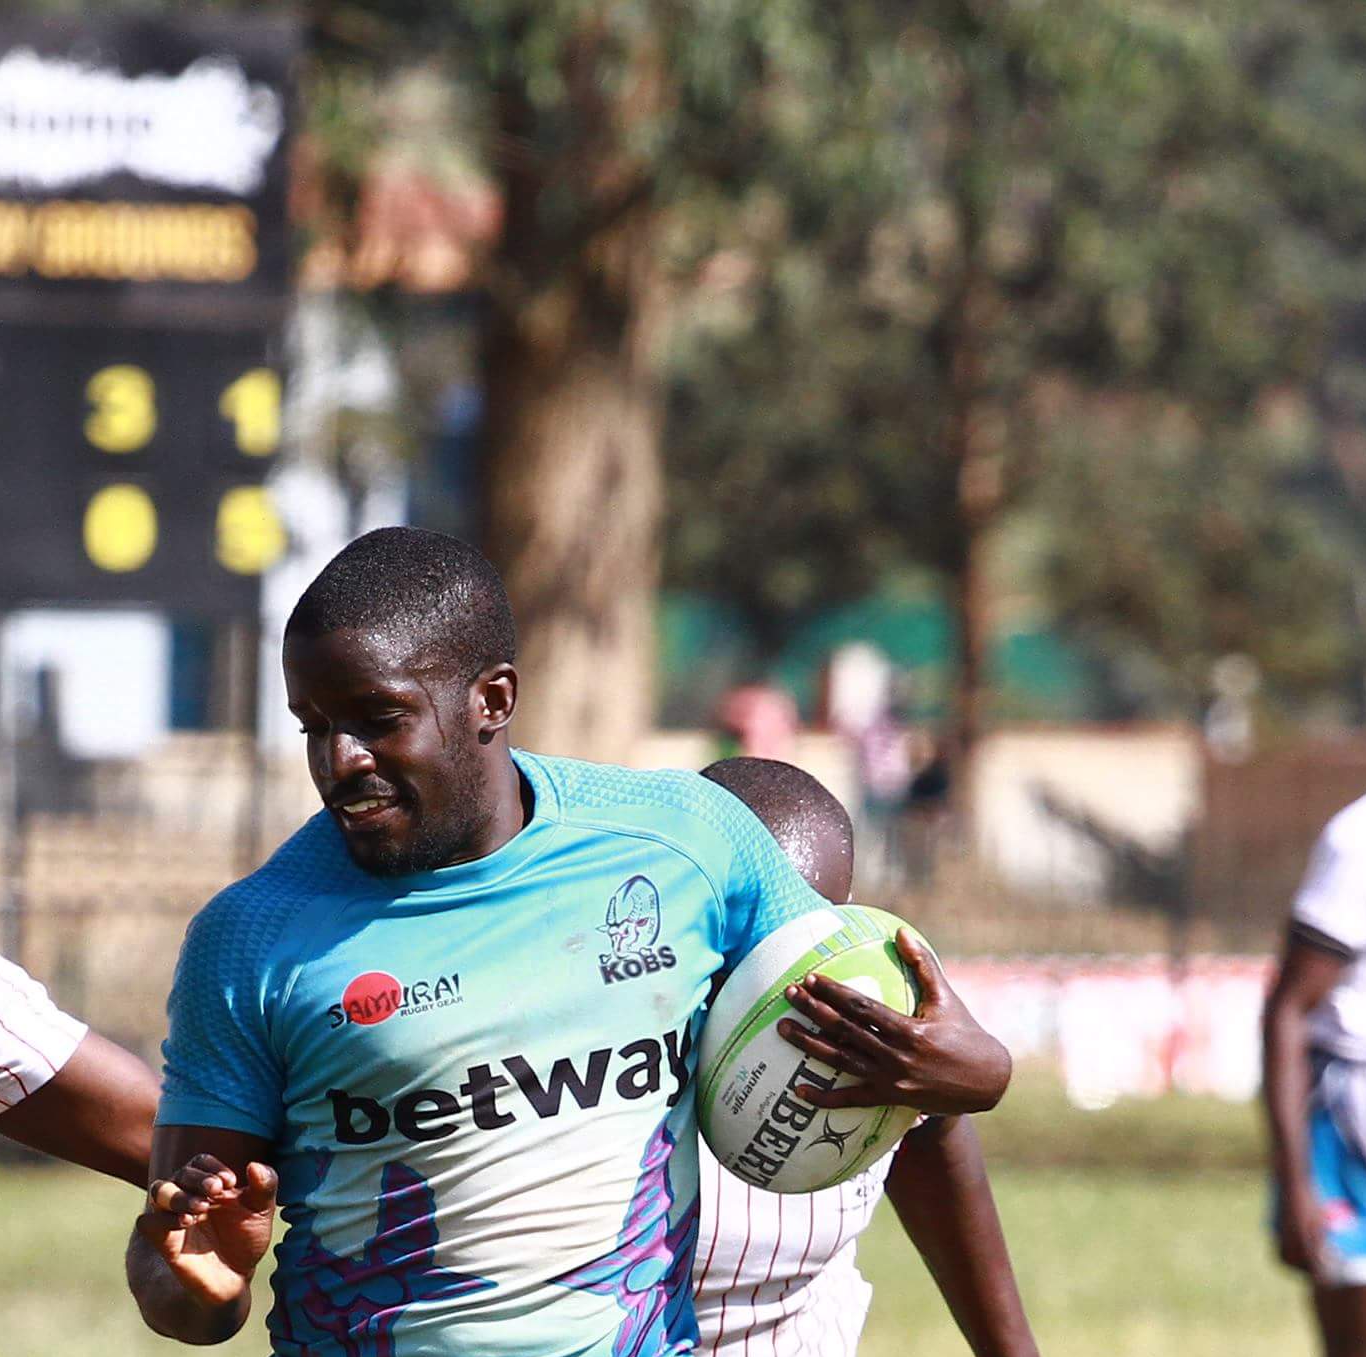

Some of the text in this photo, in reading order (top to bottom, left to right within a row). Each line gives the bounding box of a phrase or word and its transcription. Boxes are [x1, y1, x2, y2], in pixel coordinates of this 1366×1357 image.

[85, 365, 157, 453] 3
[219, 367, 282, 456] 1
[84, 484, 159, 571] 0
[327, 973, 460, 1030] SAMURAI
[400, 995, 464, 1017] RUGBY GEAR
[600, 946, 677, 985] KOBS
[325, 1019, 693, 1145] betway
[732, 1055, 843, 1188] LBERT
